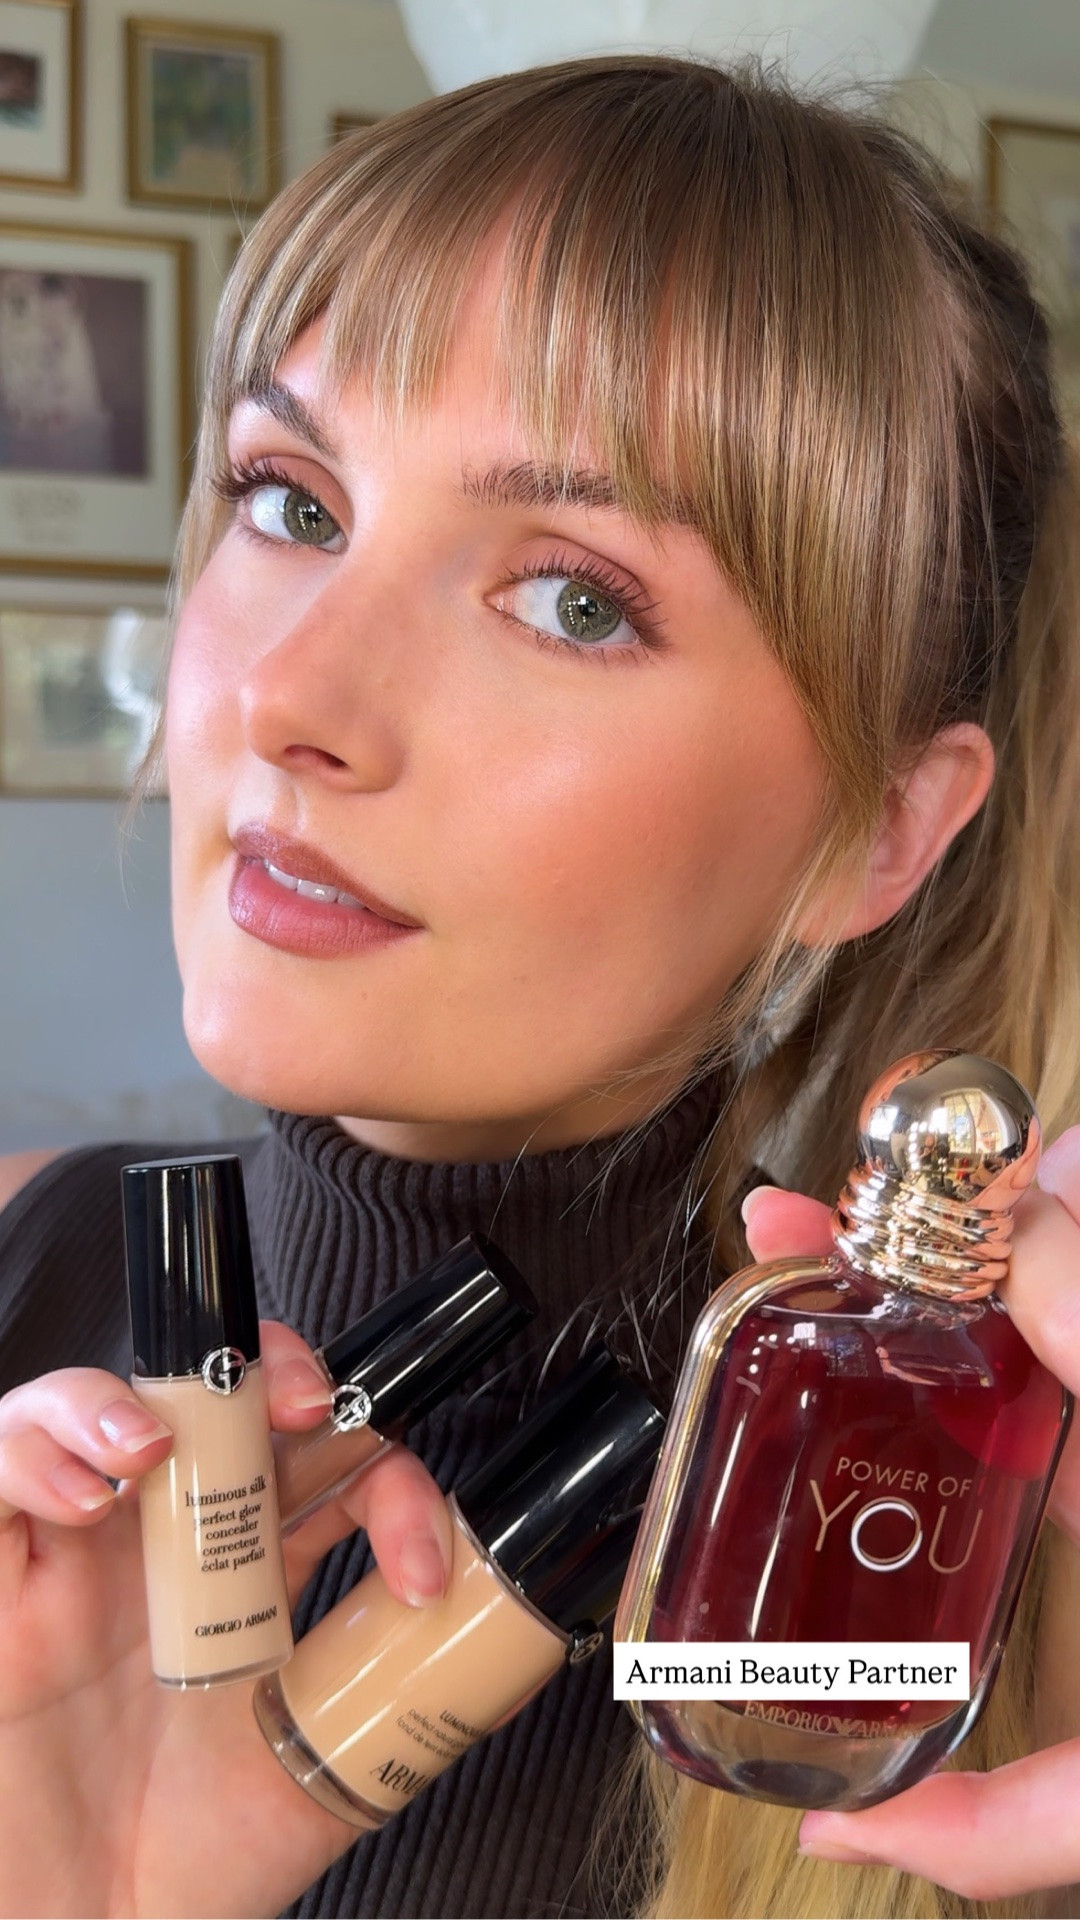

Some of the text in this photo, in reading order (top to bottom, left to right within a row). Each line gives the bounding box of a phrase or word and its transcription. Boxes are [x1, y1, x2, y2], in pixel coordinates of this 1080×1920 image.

[185, 1475, 267, 1507] luminous silk
[836, 1456, 972, 1498] POWER OF
[239, 1503, 262, 1521] glow
[809, 1479, 983, 1574] YOU
[202, 1535, 260, 1556] correcteur
[205, 1519, 259, 1540] concealer
[201, 1547, 266, 1572] éclat parfait
[195, 1605, 277, 1637] GIORGIO ARMANI
[743, 1700, 832, 1733] EMPORIO
